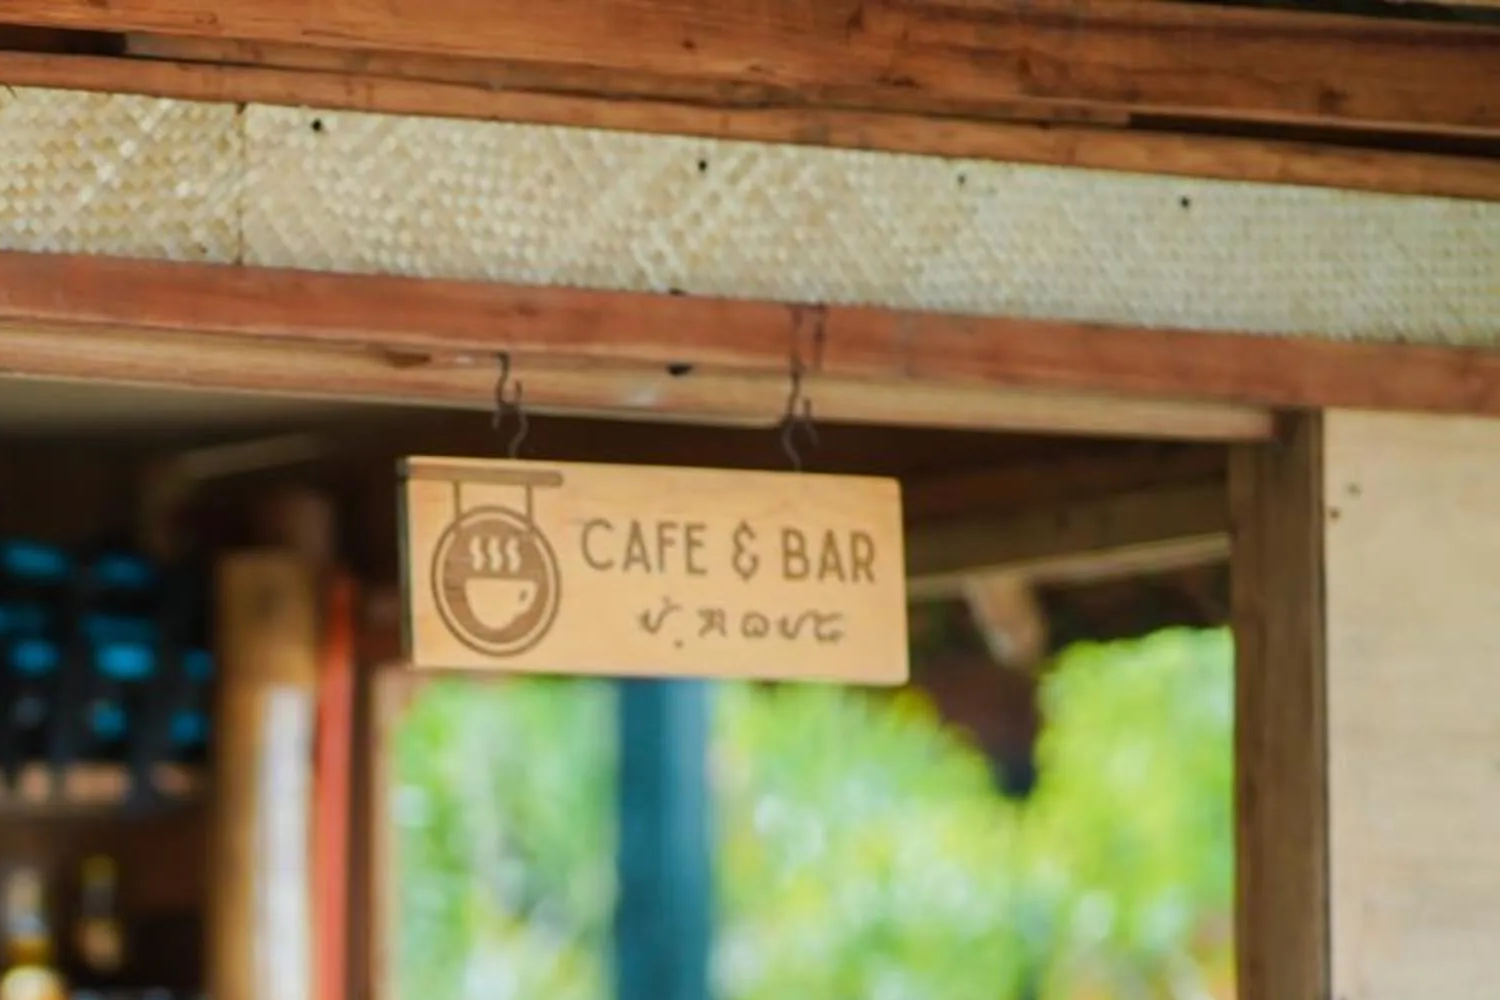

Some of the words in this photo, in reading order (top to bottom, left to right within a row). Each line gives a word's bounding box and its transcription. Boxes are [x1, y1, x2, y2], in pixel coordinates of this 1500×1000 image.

[581, 518, 708, 575] CAFE
[731, 520, 762, 582] &
[781, 526, 877, 584] BAR
